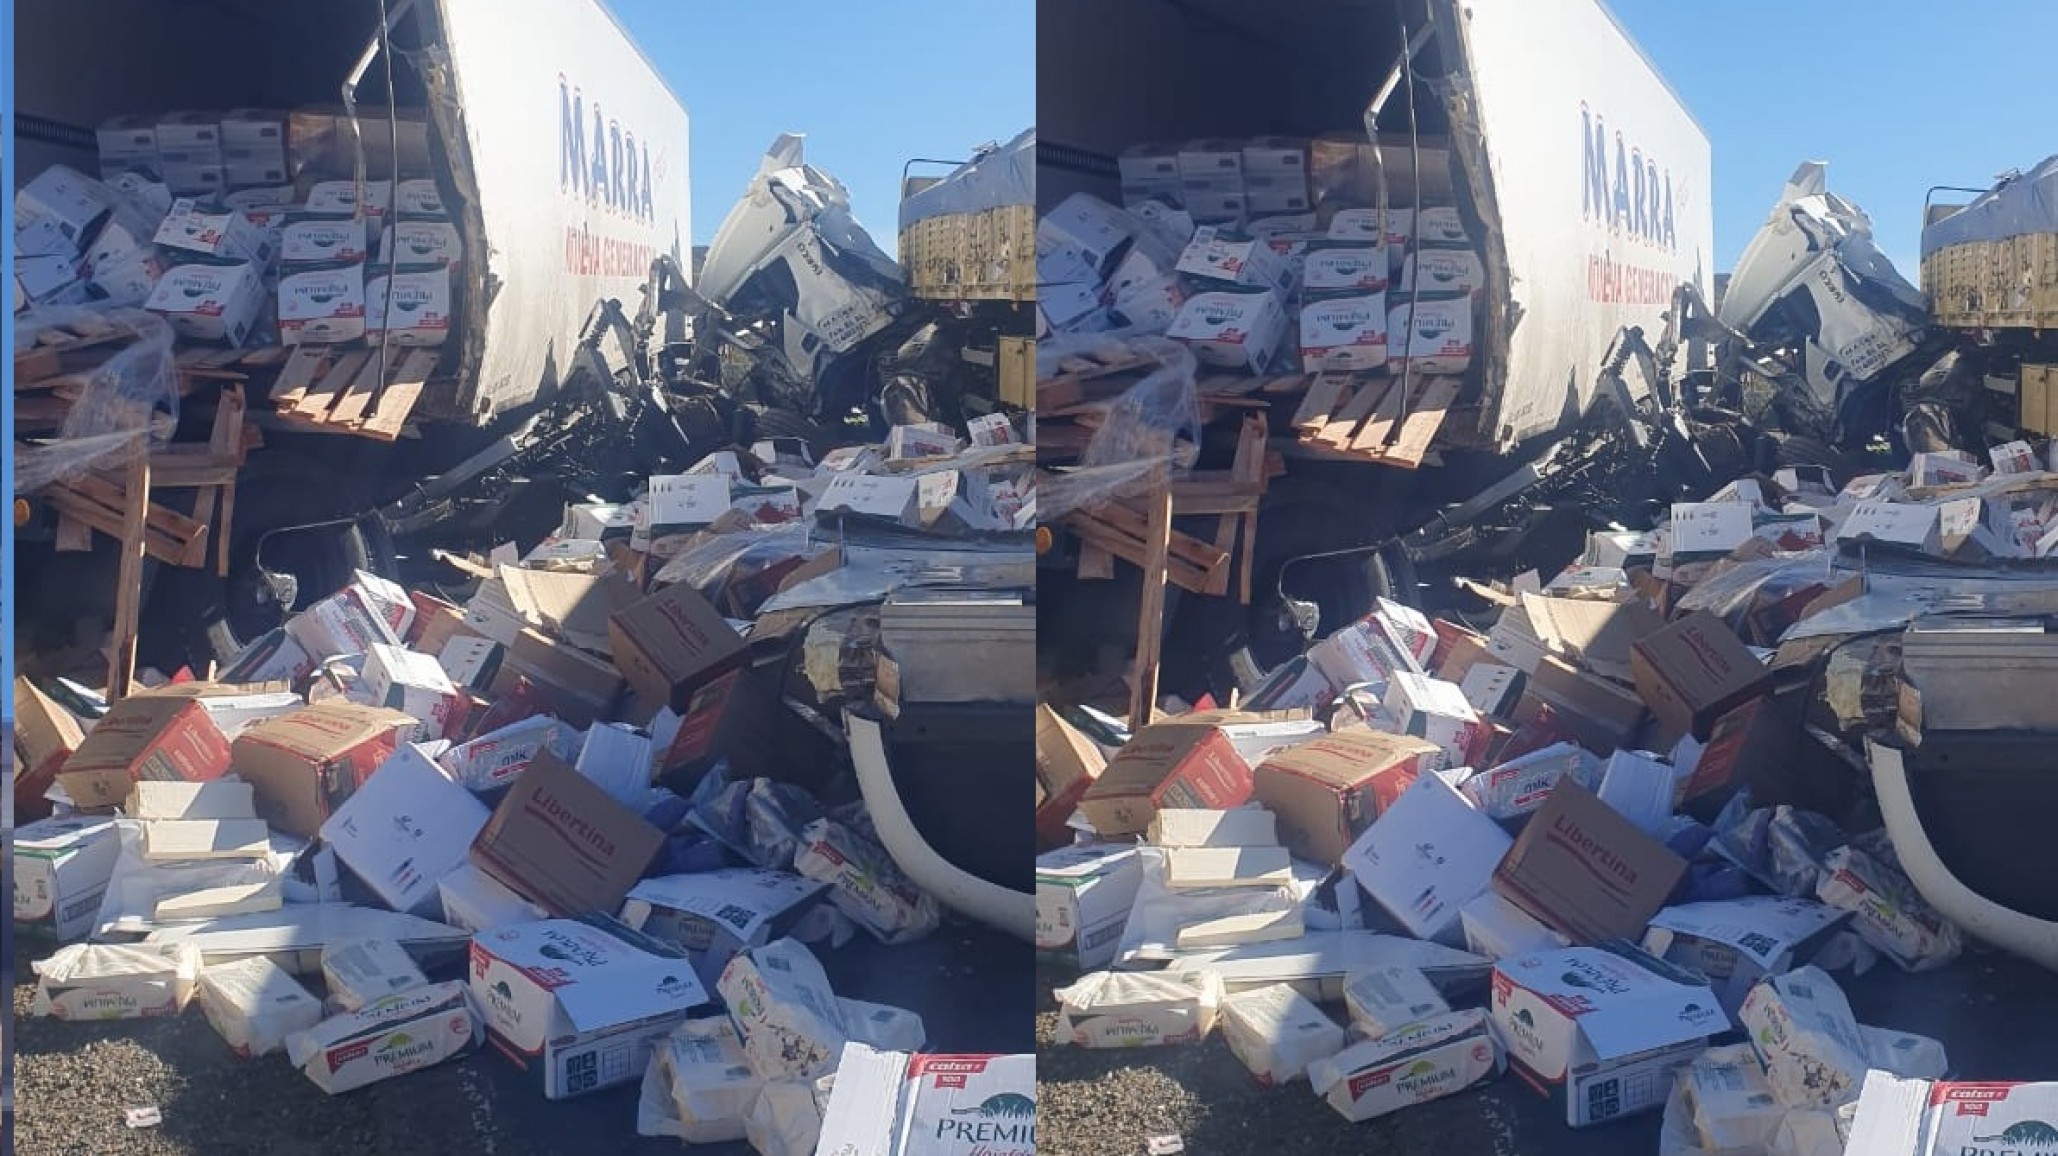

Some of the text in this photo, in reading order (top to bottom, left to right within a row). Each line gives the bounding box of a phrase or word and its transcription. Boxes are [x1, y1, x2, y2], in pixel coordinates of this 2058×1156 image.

[558, 71, 655, 227] MARRA
[1580, 99, 1677, 255] MARRA
[531, 786, 617, 858] Libertina
[1553, 814, 1639, 886] Libertina
